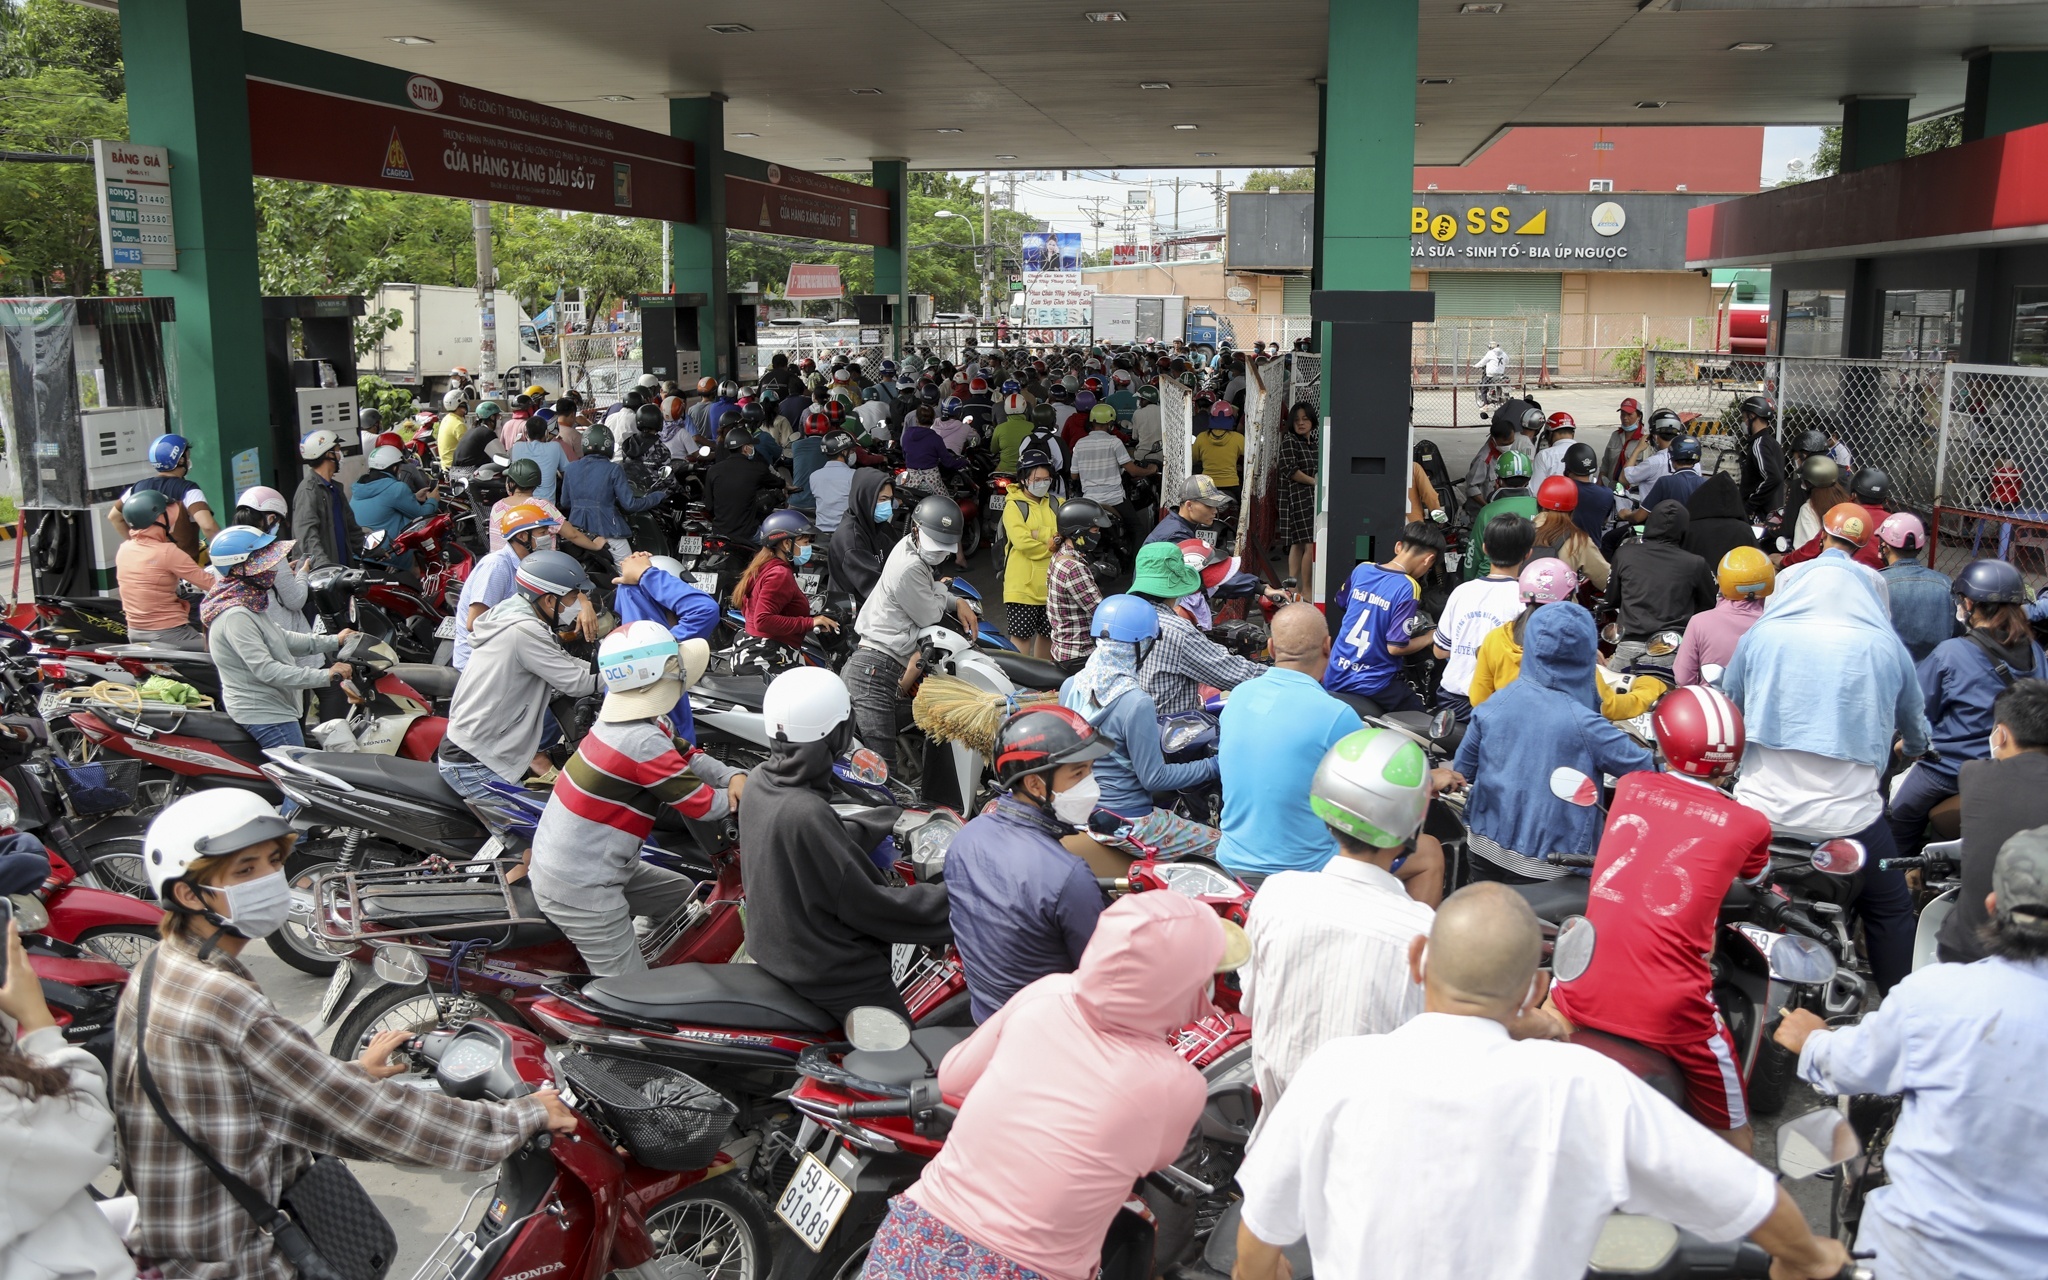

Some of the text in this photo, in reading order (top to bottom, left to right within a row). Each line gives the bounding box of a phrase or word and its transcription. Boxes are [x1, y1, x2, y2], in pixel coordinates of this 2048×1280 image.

[412, 83, 439, 103] SATRA
[111, 148, 161, 168] BẢNG GIÁ
[386, 168, 409, 178] CAGICO
[443, 142, 469, 173] CỬA
[472, 150, 509, 178] HÀNG
[512, 157, 546, 184] XĂNG
[548, 160, 569, 187] DẦU
[571, 165, 585, 189] SỐ
[586, 172, 596, 190] 17
[109, 188, 165, 204] RON 95 21440
[141, 214, 167, 223] 23580
[113, 230, 122, 238] DO
[142, 234, 168, 243] 22200
[130, 250, 140, 261] E5
[1428, 243, 1455, 258] SỮA
[1466, 246, 1497, 258] SINH
[1501, 241, 1520, 258] TỐ
[1529, 246, 1551, 258] BIA
[1555, 243, 1572, 259] ÚP
[1575, 245, 1628, 262] NGƯỢC
[170, 445, 180, 460] ZTO
[1464, 538, 1475, 569] Grab
[1351, 588, 1369, 602] Thái
[1344, 608, 1371, 659] 4
[1338, 656, 1351, 670] FC
[604, 666, 627, 680] DCL
[363, 738, 392, 746] HONDA
[1591, 813, 1705, 917] 26
[68, 1023, 101, 1034] HONDA
[676, 1030, 711, 1040] AIR
[711, 1033, 773, 1045] BLADE
[800, 1162, 841, 1213] 59-Y1
[781, 1186, 829, 1244] 919.89
[503, 1261, 567, 1280] HONDA
